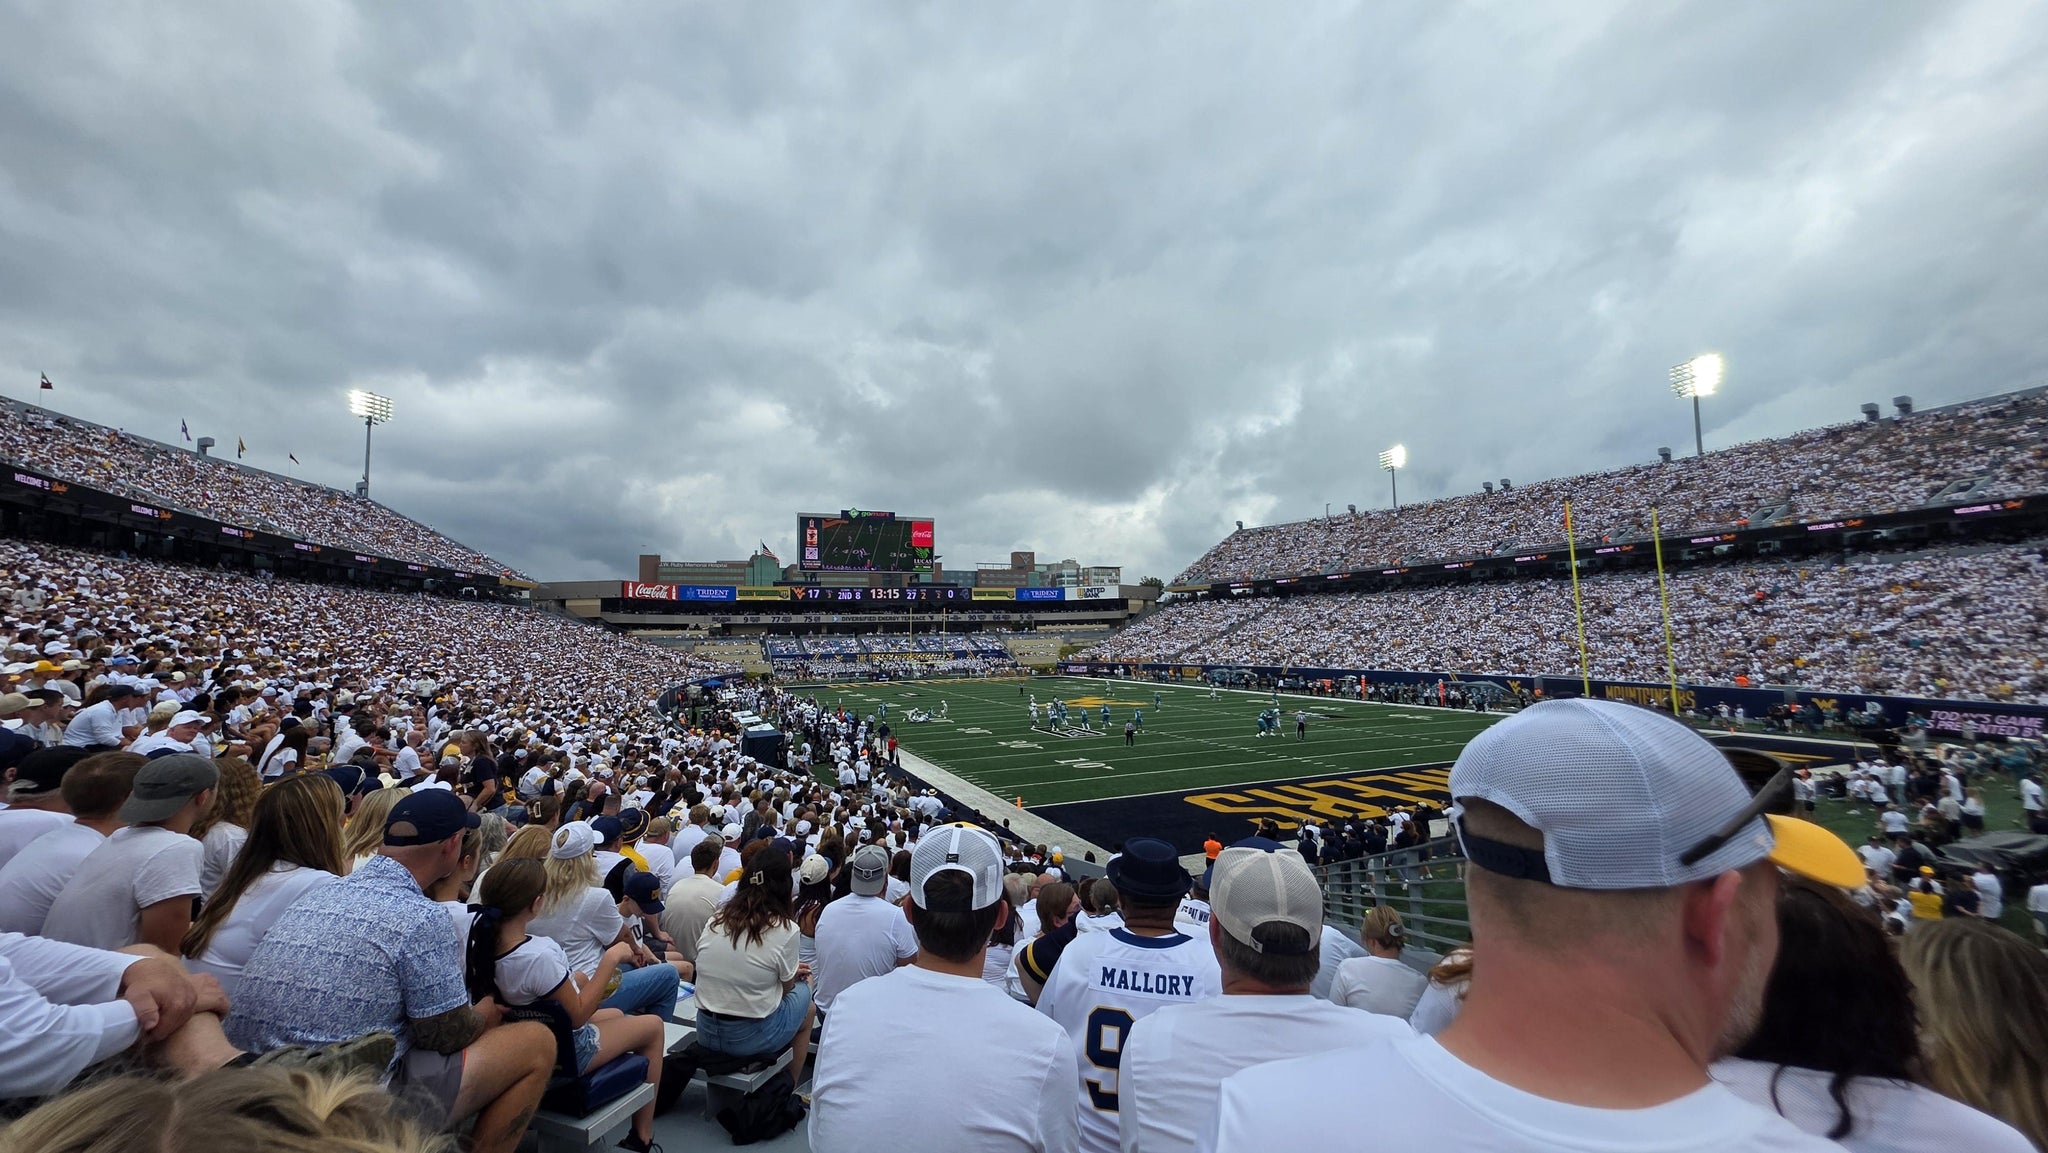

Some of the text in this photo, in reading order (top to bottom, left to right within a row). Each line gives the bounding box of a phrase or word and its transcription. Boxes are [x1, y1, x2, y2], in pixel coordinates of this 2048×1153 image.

[14, 473, 42, 487] WELCOME
[131, 504, 153, 516] WELCOME
[1953, 504, 1991, 514] WELCOME
[696, 588, 729, 596] TRIDENT
[807, 589, 819, 599] 17
[837, 592, 853, 600] 2ND
[855, 592, 861, 600] 8
[870, 588, 900, 599] 13:15
[906, 591, 917, 600] 27
[947, 589, 954, 599] 0
[1605, 684, 1696, 709] MOUNTAINERS
[1936, 720, 2019, 736] PREENTED
[1995, 715, 2043, 728] GAME
[1100, 966, 1194, 996] MALLORY
[1084, 1005, 1136, 1113] 9
